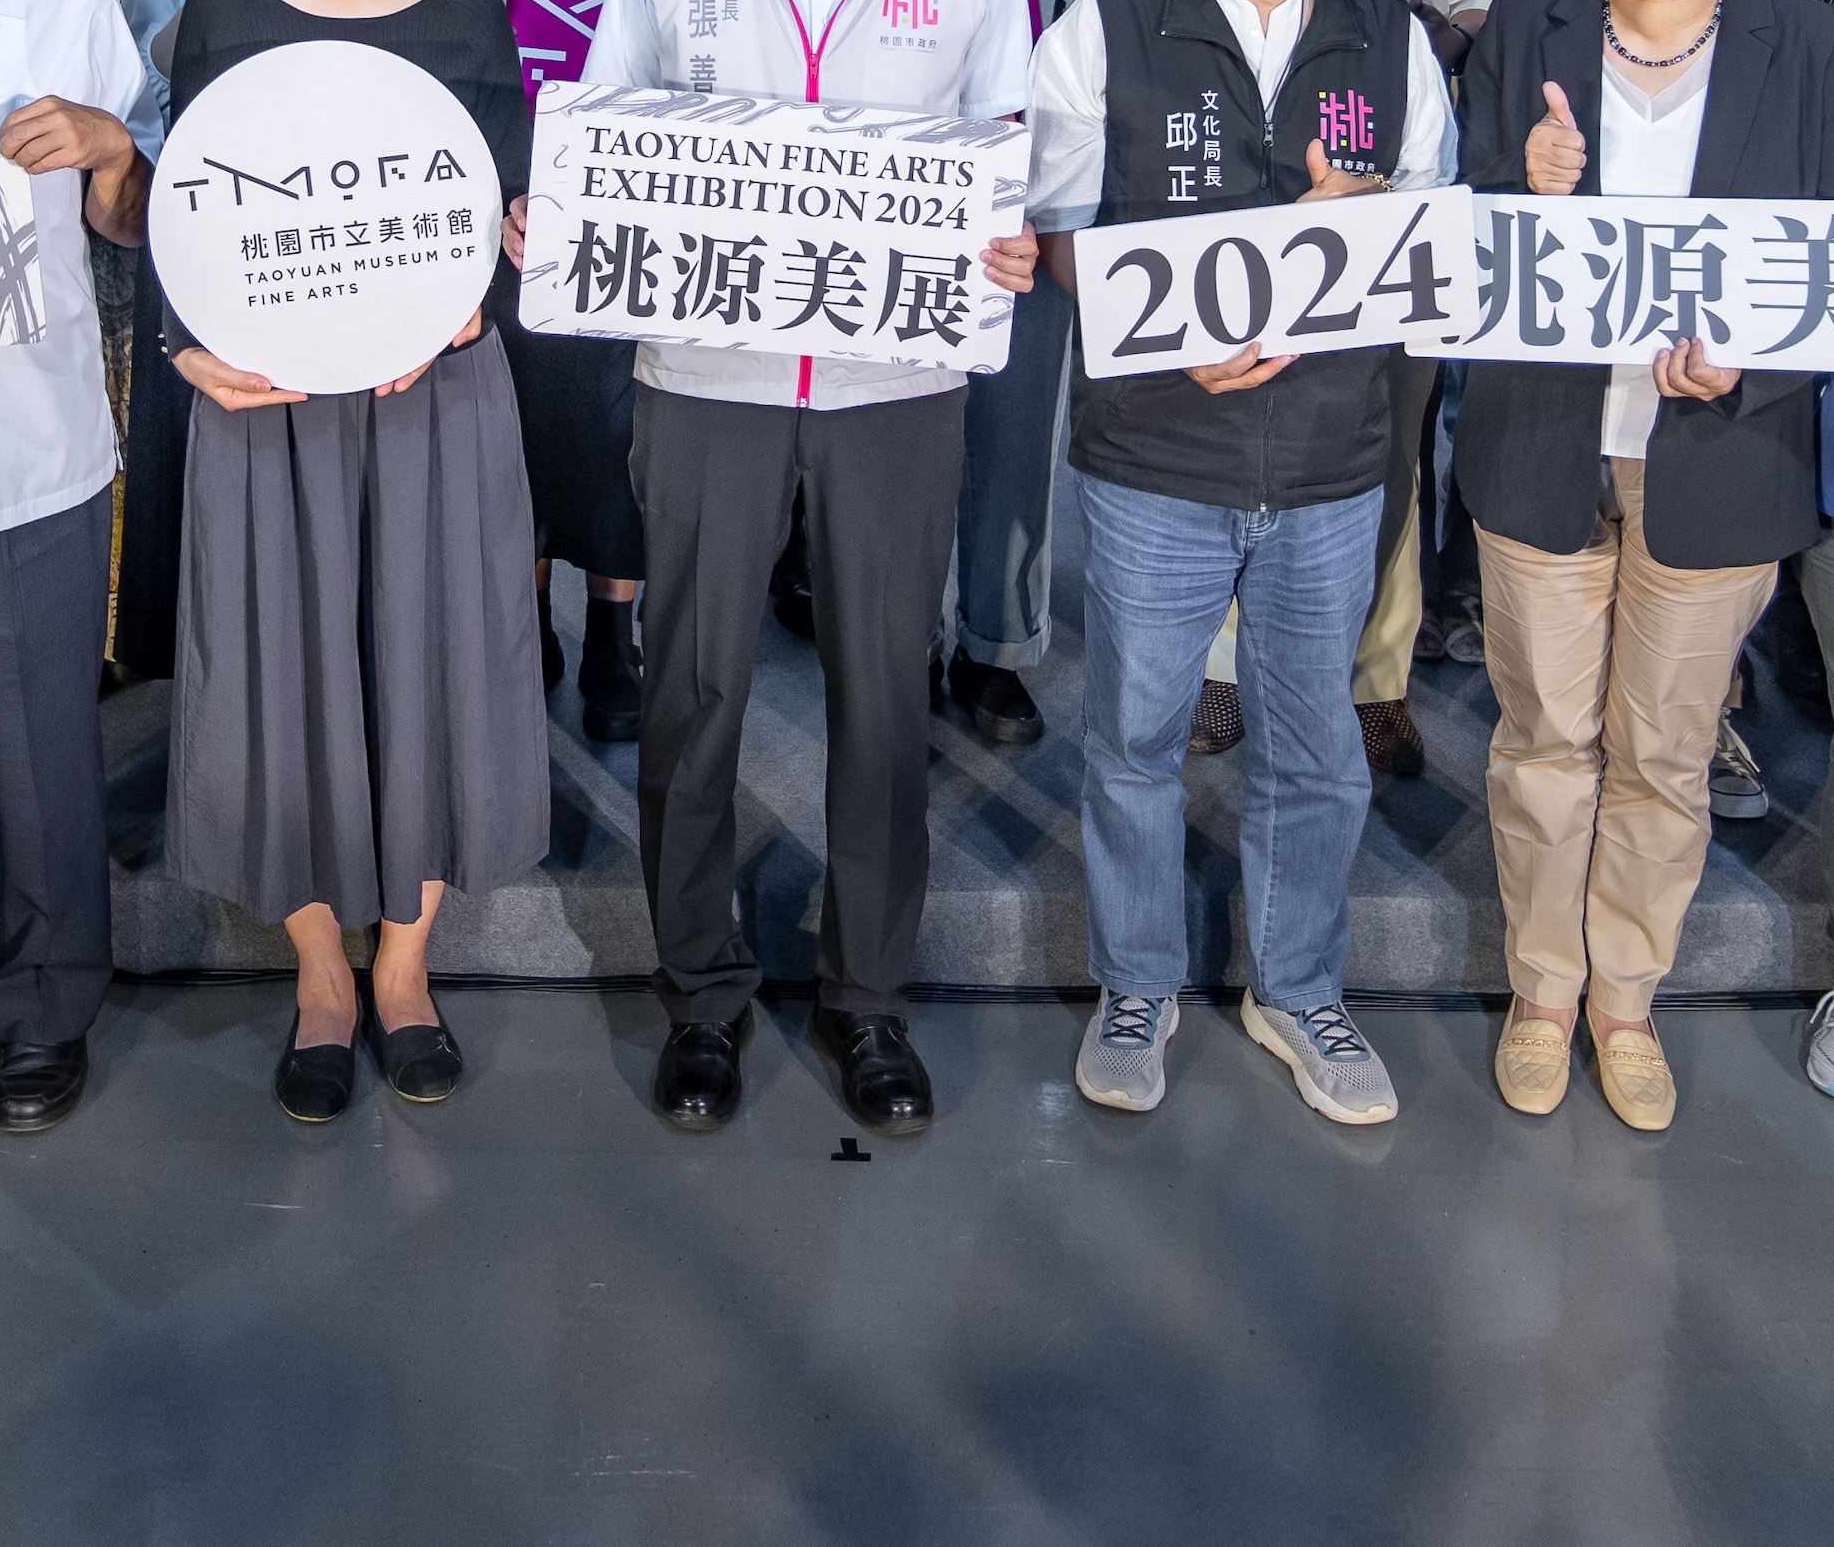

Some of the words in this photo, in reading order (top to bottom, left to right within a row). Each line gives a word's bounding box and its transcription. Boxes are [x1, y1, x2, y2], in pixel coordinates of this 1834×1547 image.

[688, 0, 717, 93] 張善
[586, 126, 772, 168] TAOYUAN
[780, 144, 868, 177] FINE
[876, 154, 974, 187] ARTS
[1166, 112, 1198, 202] 邱正
[1201, 90, 1222, 188] 文化局長
[1326, 158, 1376, 173] 園市政府
[580, 166, 868, 221] EXHIBITION
[875, 193, 969, 230] 2024
[241, 208, 473, 261] 桃園市立美術館
[245, 263, 342, 285] TAOYUAN
[354, 251, 439, 271] MUSEUM
[451, 246, 476, 258] OF
[249, 291, 295, 307] FINE
[308, 283, 359, 299] ARTS
[564, 220, 972, 347] 桃源美展
[1106, 204, 1452, 358] 2024
